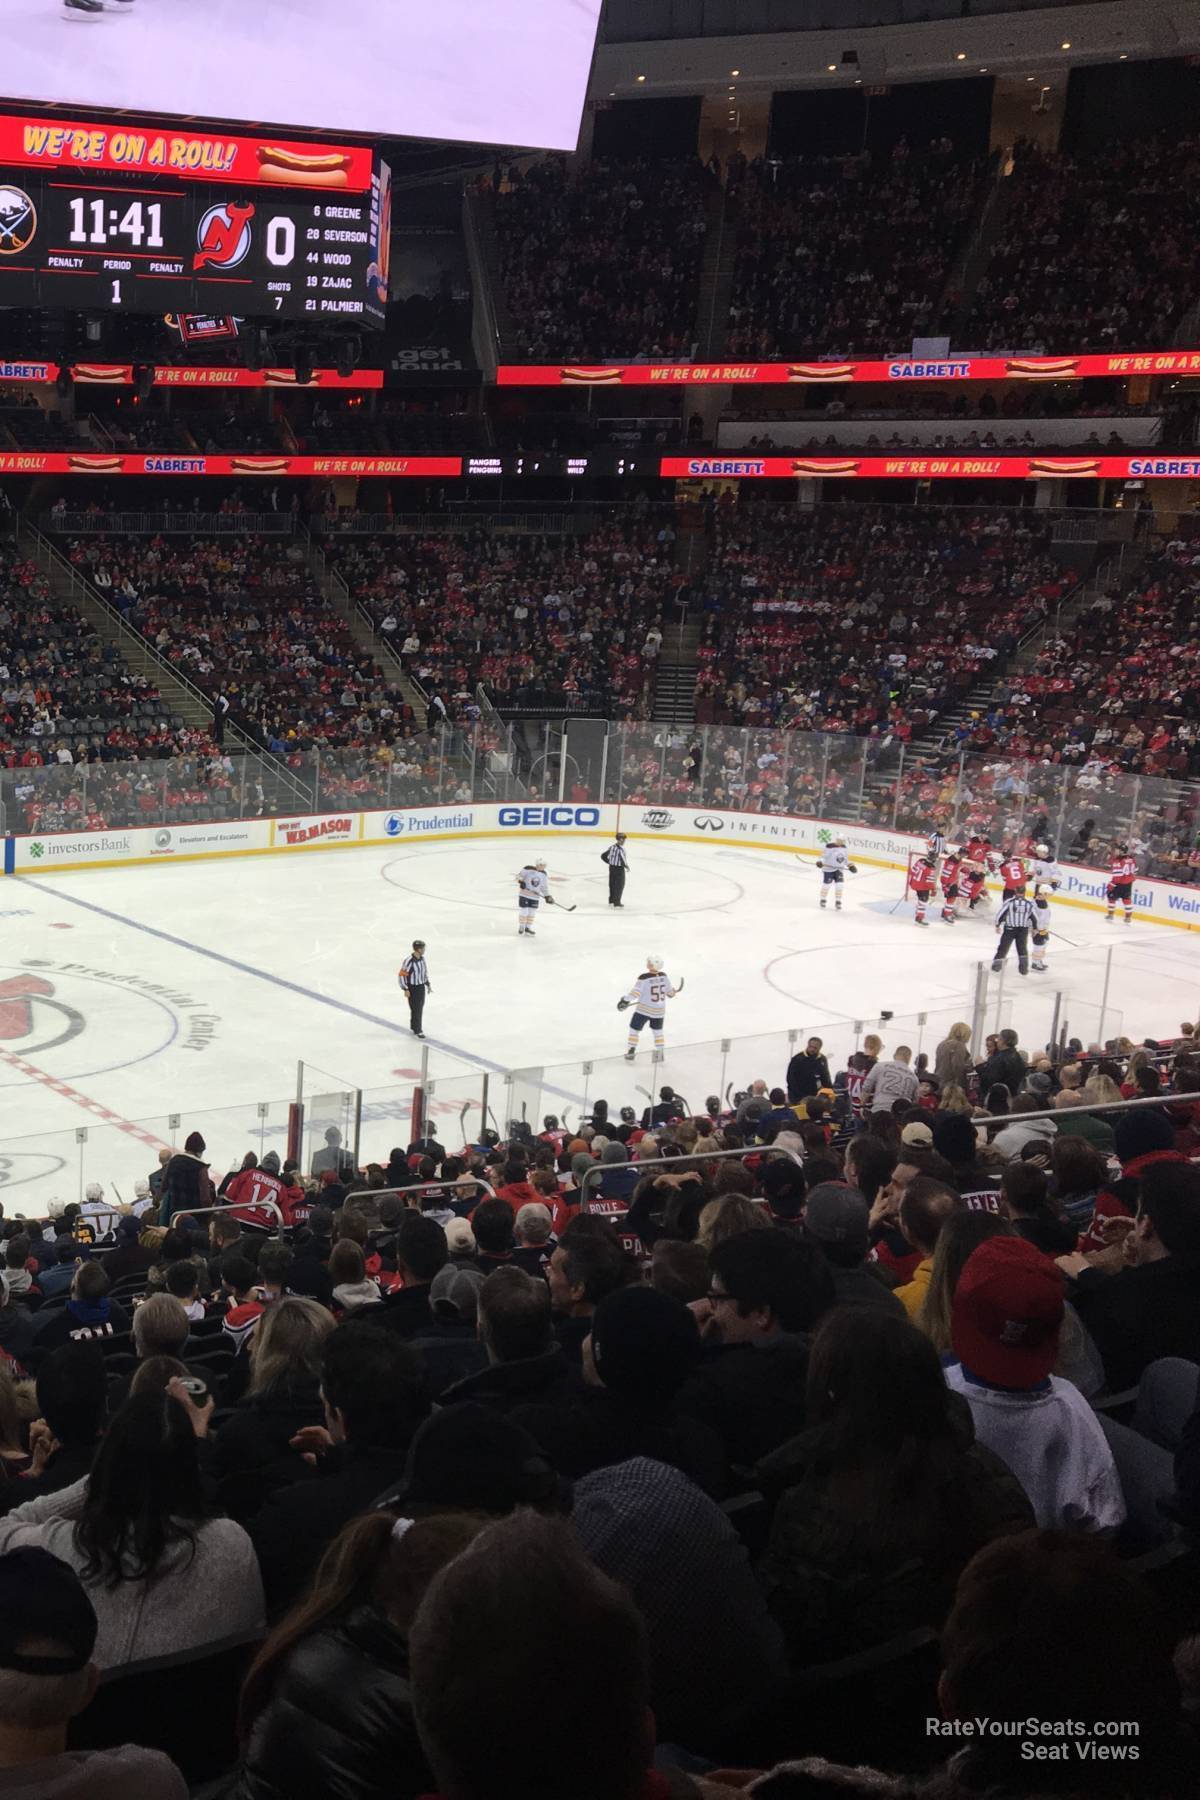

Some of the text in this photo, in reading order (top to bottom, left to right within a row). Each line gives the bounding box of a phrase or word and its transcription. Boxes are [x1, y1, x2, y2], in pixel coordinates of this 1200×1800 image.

[23, 126, 238, 171] WE'RE ON A ROLL!
[313, 206, 361, 220] 6 GREENE
[69, 197, 163, 247] 11:41
[266, 216, 296, 266] 0
[306, 229, 368, 243] 28 SEVERSON
[48, 257, 184, 273] PENALTY PERIOD PENALTY
[306, 252, 351, 265] 44 WOOD
[267, 281, 291, 292] SHOTS
[306, 276, 352, 289] 19 ZAJAC
[111, 280, 122, 303] 1
[275, 297, 283, 310] 7
[305, 300, 364, 313] 21 PALMIERI
[398, 347, 450, 362] get
[391, 360, 462, 370] loud
[888, 361, 970, 378] SABRETT
[1108, 357, 1152, 371] WE'RE
[1155, 356, 1175, 370] ON
[1177, 356, 1188, 369] A
[183, 370, 239, 383] ON ROLL!
[650, 367, 757, 380] WE'RE ON ROLL!
[7, 457, 15, 469] A
[17, 457, 47, 469] ROLL!
[144, 457, 205, 473] SABRETT
[313, 461, 408, 472] WE'RE ON ROLL!
[689, 460, 765, 476] SABRETT
[885, 461, 1001, 474] WE'RE ON ROLL!
[408, 814, 473, 832] Prudential
[498, 807, 600, 827] GEICO
[730, 821, 806, 838] INFINITI
[179, 833, 248, 844] Elevators and Escalators
[1010, 866, 1021, 879] 6
[651, 985, 665, 1002] 55
[59, 963, 221, 1051] Prudential Center
[248, 1183, 278, 1218] 14
